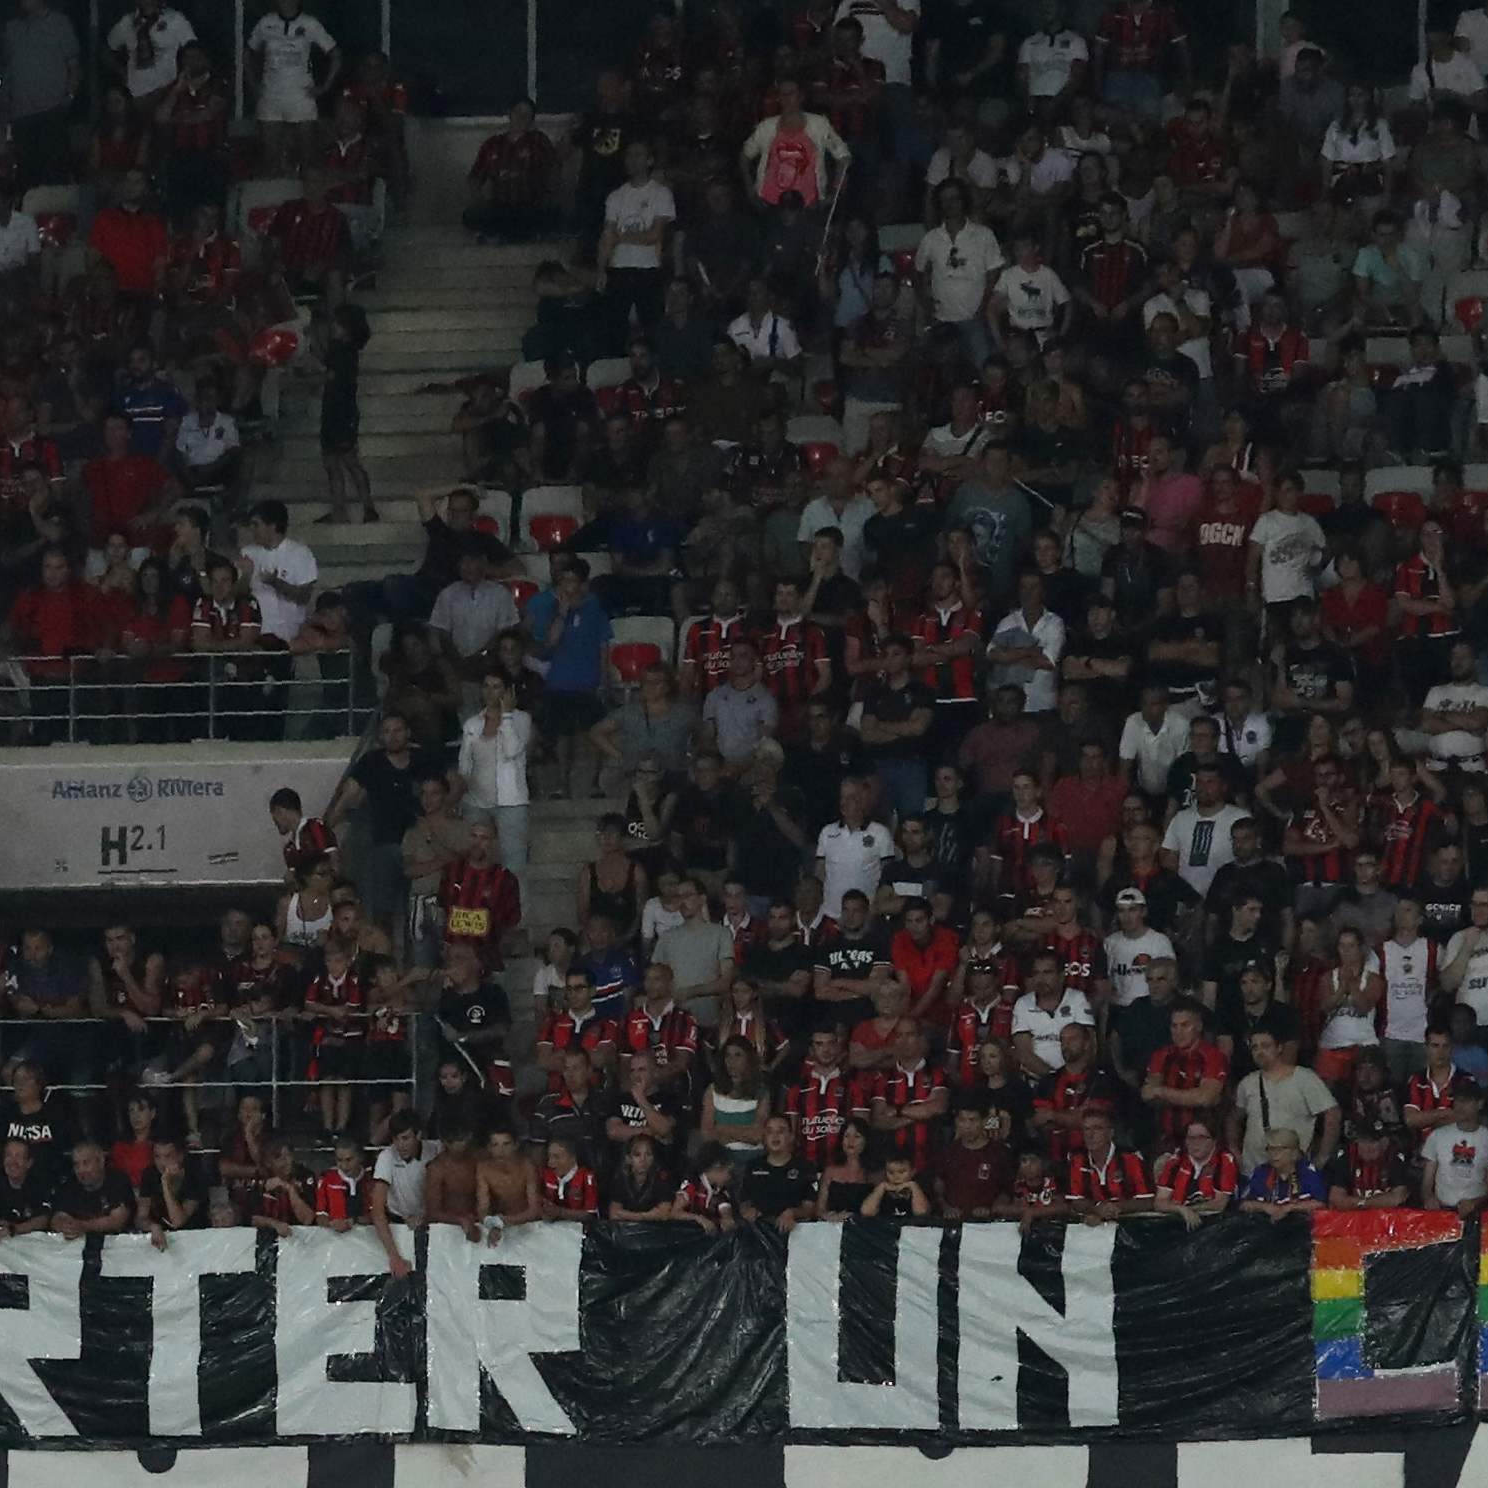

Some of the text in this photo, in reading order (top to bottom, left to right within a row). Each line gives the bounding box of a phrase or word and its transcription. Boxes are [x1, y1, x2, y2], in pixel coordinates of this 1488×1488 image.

[51, 778, 225, 800] Allianz Riviera
[784, 1221, 1118, 1432] UN
